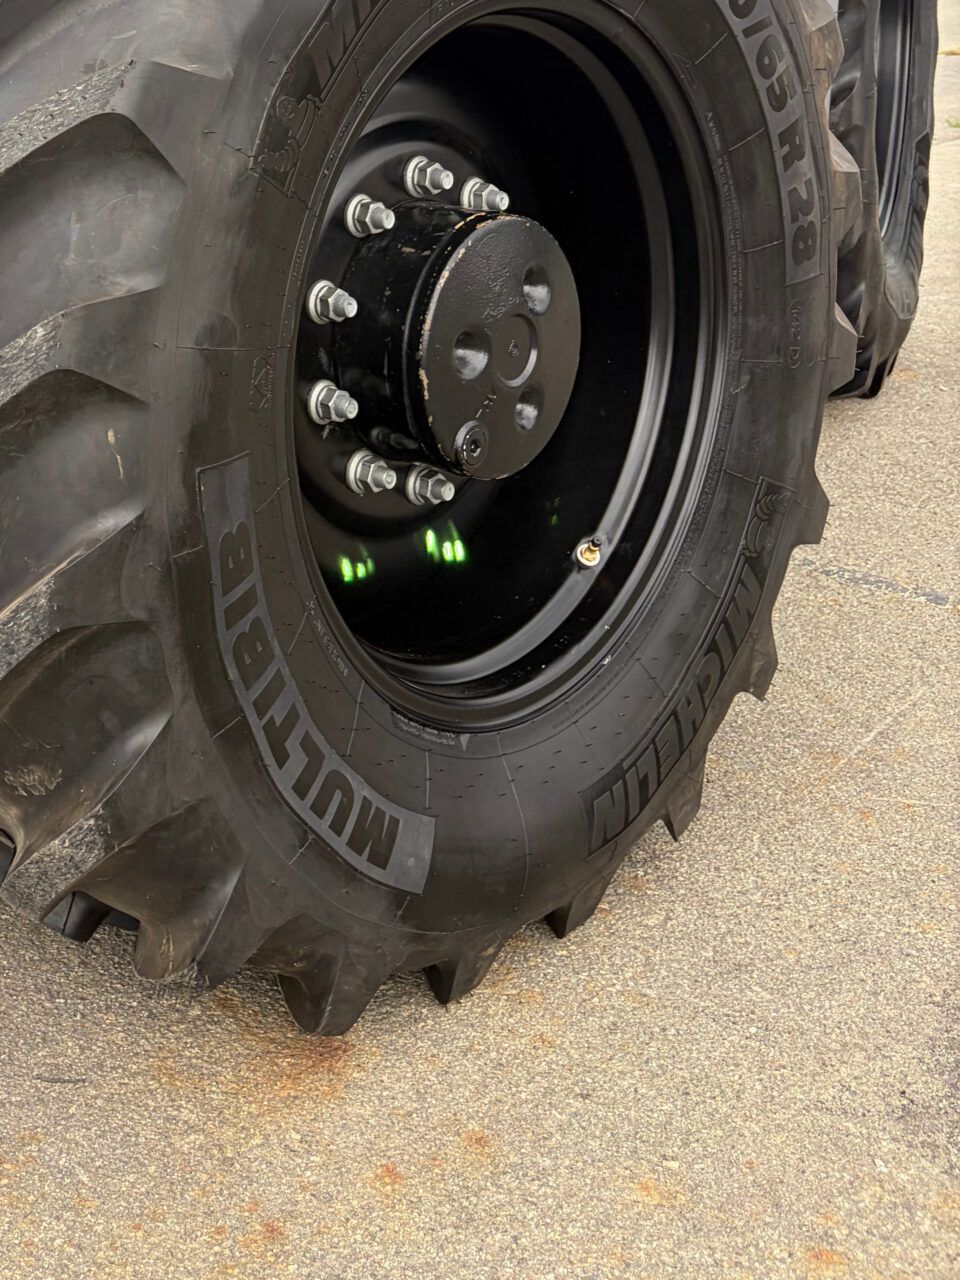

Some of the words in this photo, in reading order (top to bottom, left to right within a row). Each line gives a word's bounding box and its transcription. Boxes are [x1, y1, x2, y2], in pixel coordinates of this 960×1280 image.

[786, 186, 820, 267] 28
[218, 520, 401, 871] MULTIBIB
[589, 563, 763, 856] MICHELIN
